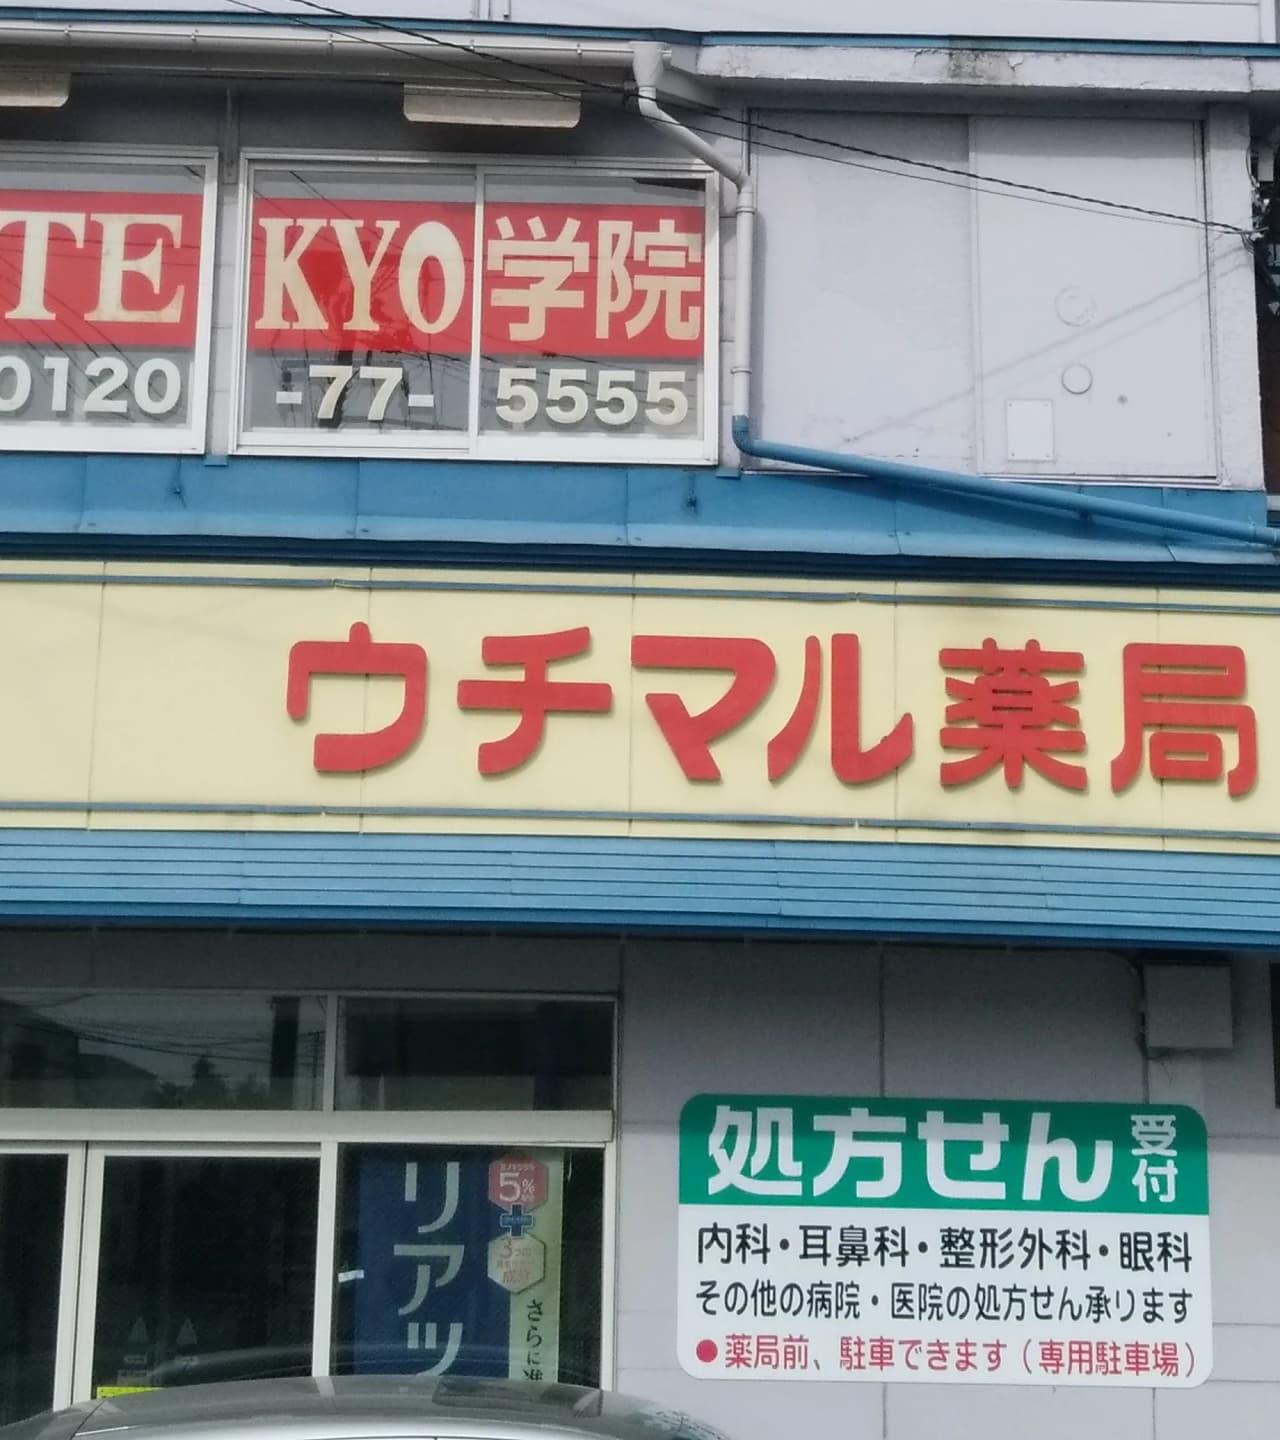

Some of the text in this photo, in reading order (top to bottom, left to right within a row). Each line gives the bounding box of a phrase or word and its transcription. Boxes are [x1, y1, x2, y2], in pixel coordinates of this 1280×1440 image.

[286, 620, 1258, 798] ウチマル薬局
[707, 1105, 1179, 1203] 処方せん 受付
[697, 1222, 1193, 1273] 内科・耳鼻科・整形外科・眼科
[695, 1279, 1194, 1325] その他の病院・医院の処方せん承ります
